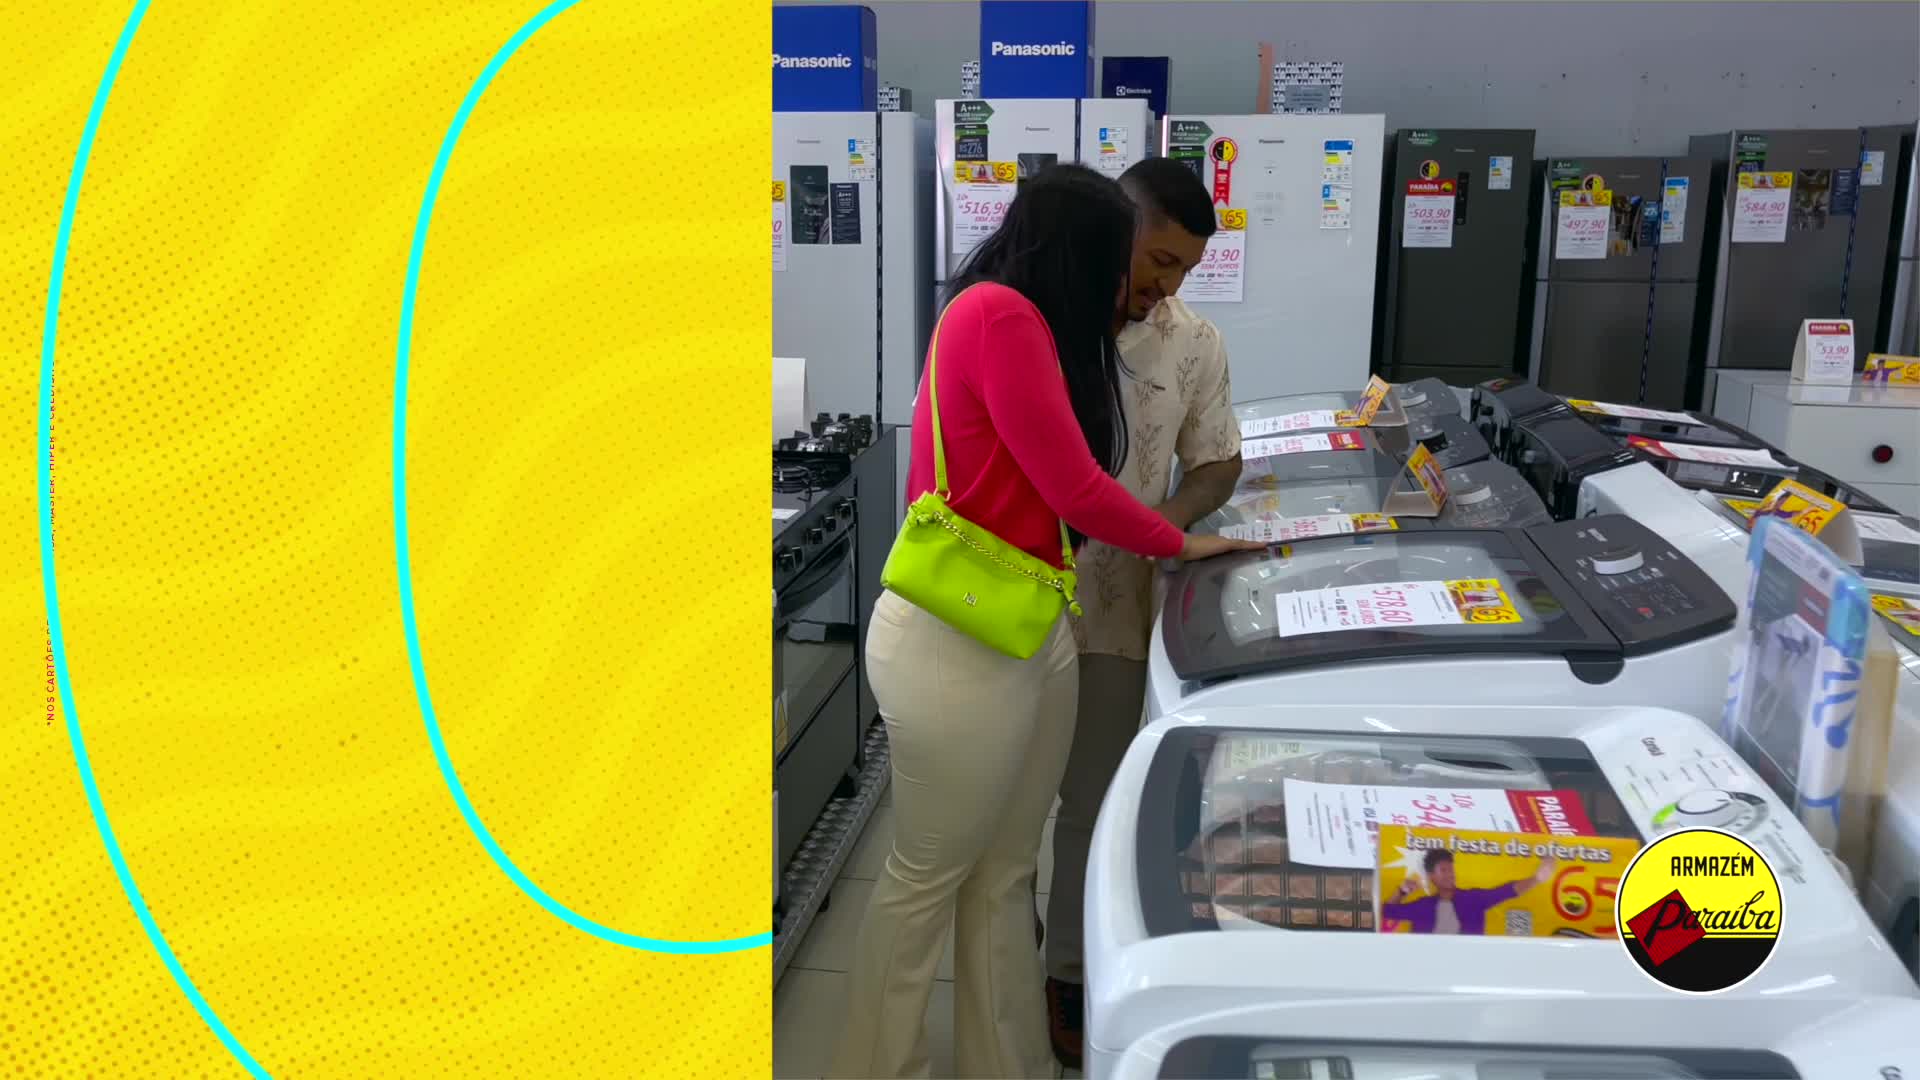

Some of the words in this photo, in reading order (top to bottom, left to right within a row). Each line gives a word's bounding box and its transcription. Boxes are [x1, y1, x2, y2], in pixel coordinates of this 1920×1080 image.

[992, 41, 1075, 56] Panasonic
[772, 53, 852, 68] Panasonic
[1177, 123, 1200, 132] A+++
[997, 162, 1015, 180] 65
[1225, 209, 1244, 227] 65
[1372, 589, 1414, 624] 578,60
[1472, 608, 1512, 623] 65
[1450, 793, 1474, 810] 10x
[1391, 813, 1410, 828] SE
[1405, 831, 1445, 851] tem
[1449, 835, 1501, 856] festa
[1504, 838, 1530, 856] de
[1534, 841, 1612, 863] ofertas
